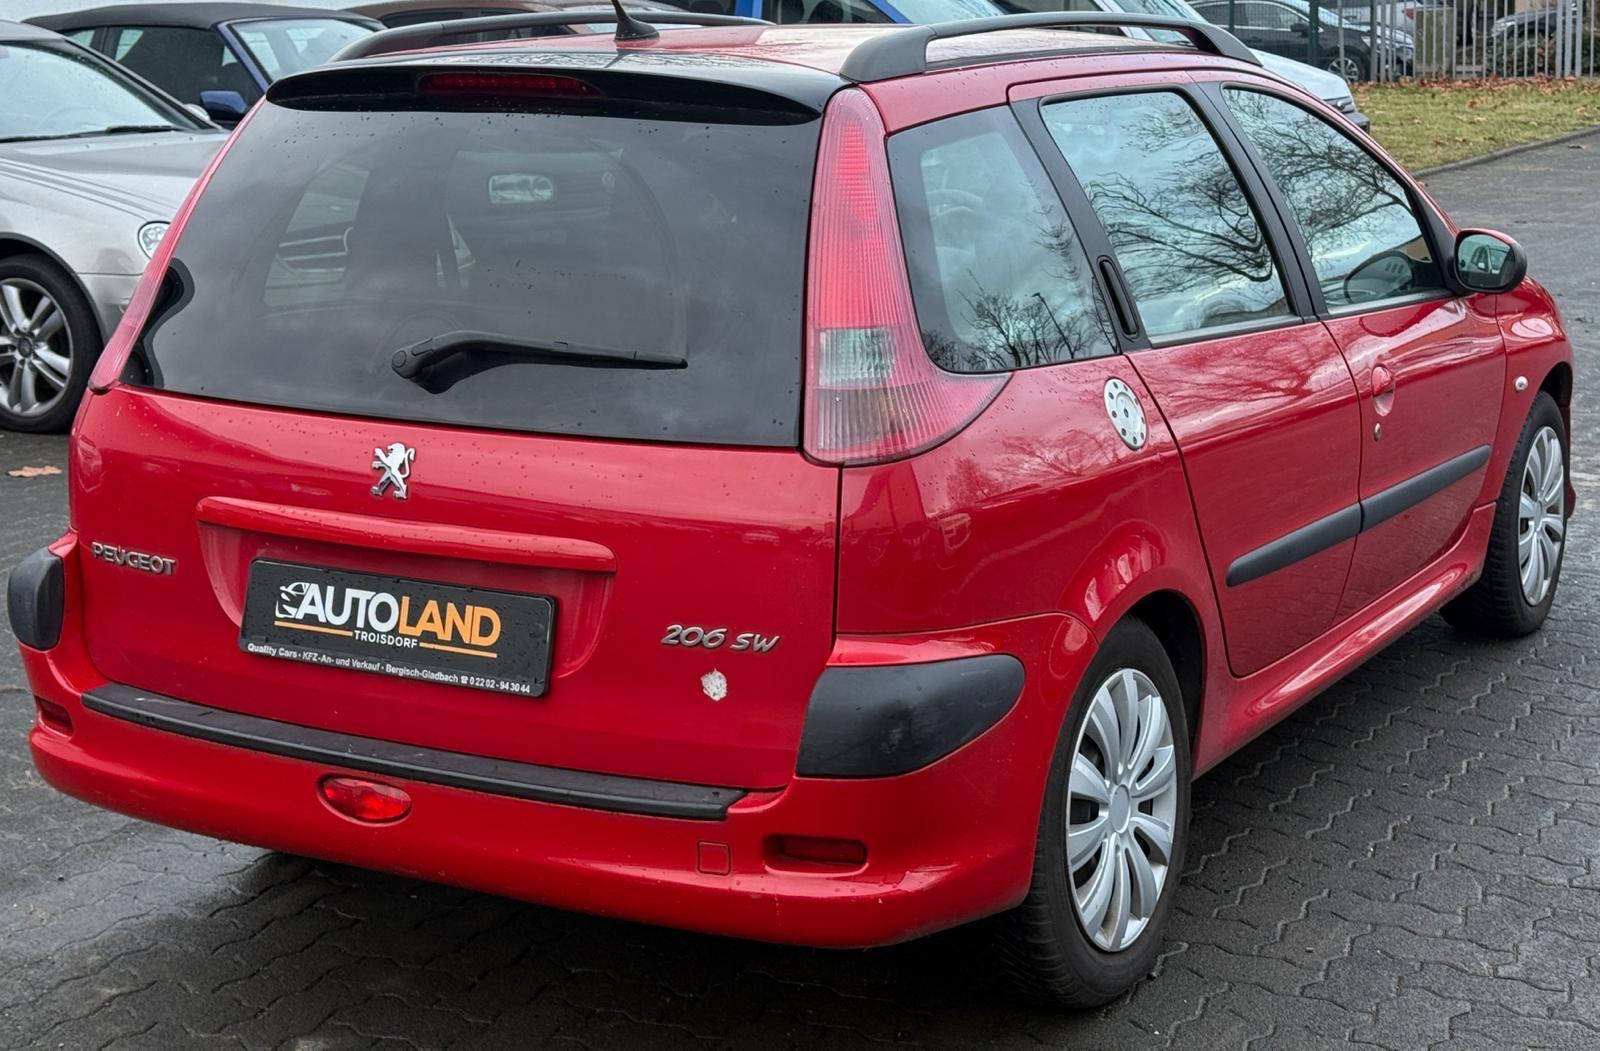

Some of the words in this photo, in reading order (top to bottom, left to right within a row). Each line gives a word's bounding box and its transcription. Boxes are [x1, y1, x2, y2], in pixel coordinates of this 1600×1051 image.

[92, 541, 176, 575] PEUGEOT
[295, 583, 501, 647] AUTOLAND
[354, 630, 418, 649] TROISDORF
[661, 624, 727, 648] 206
[730, 633, 780, 652] SW
[248, 643, 277, 657] Quality
[279, 648, 297, 658] Cars
[336, 658, 350, 666] und
[351, 659, 380, 671] Verkauf
[386, 664, 458, 683] Bergisch-Gladbach
